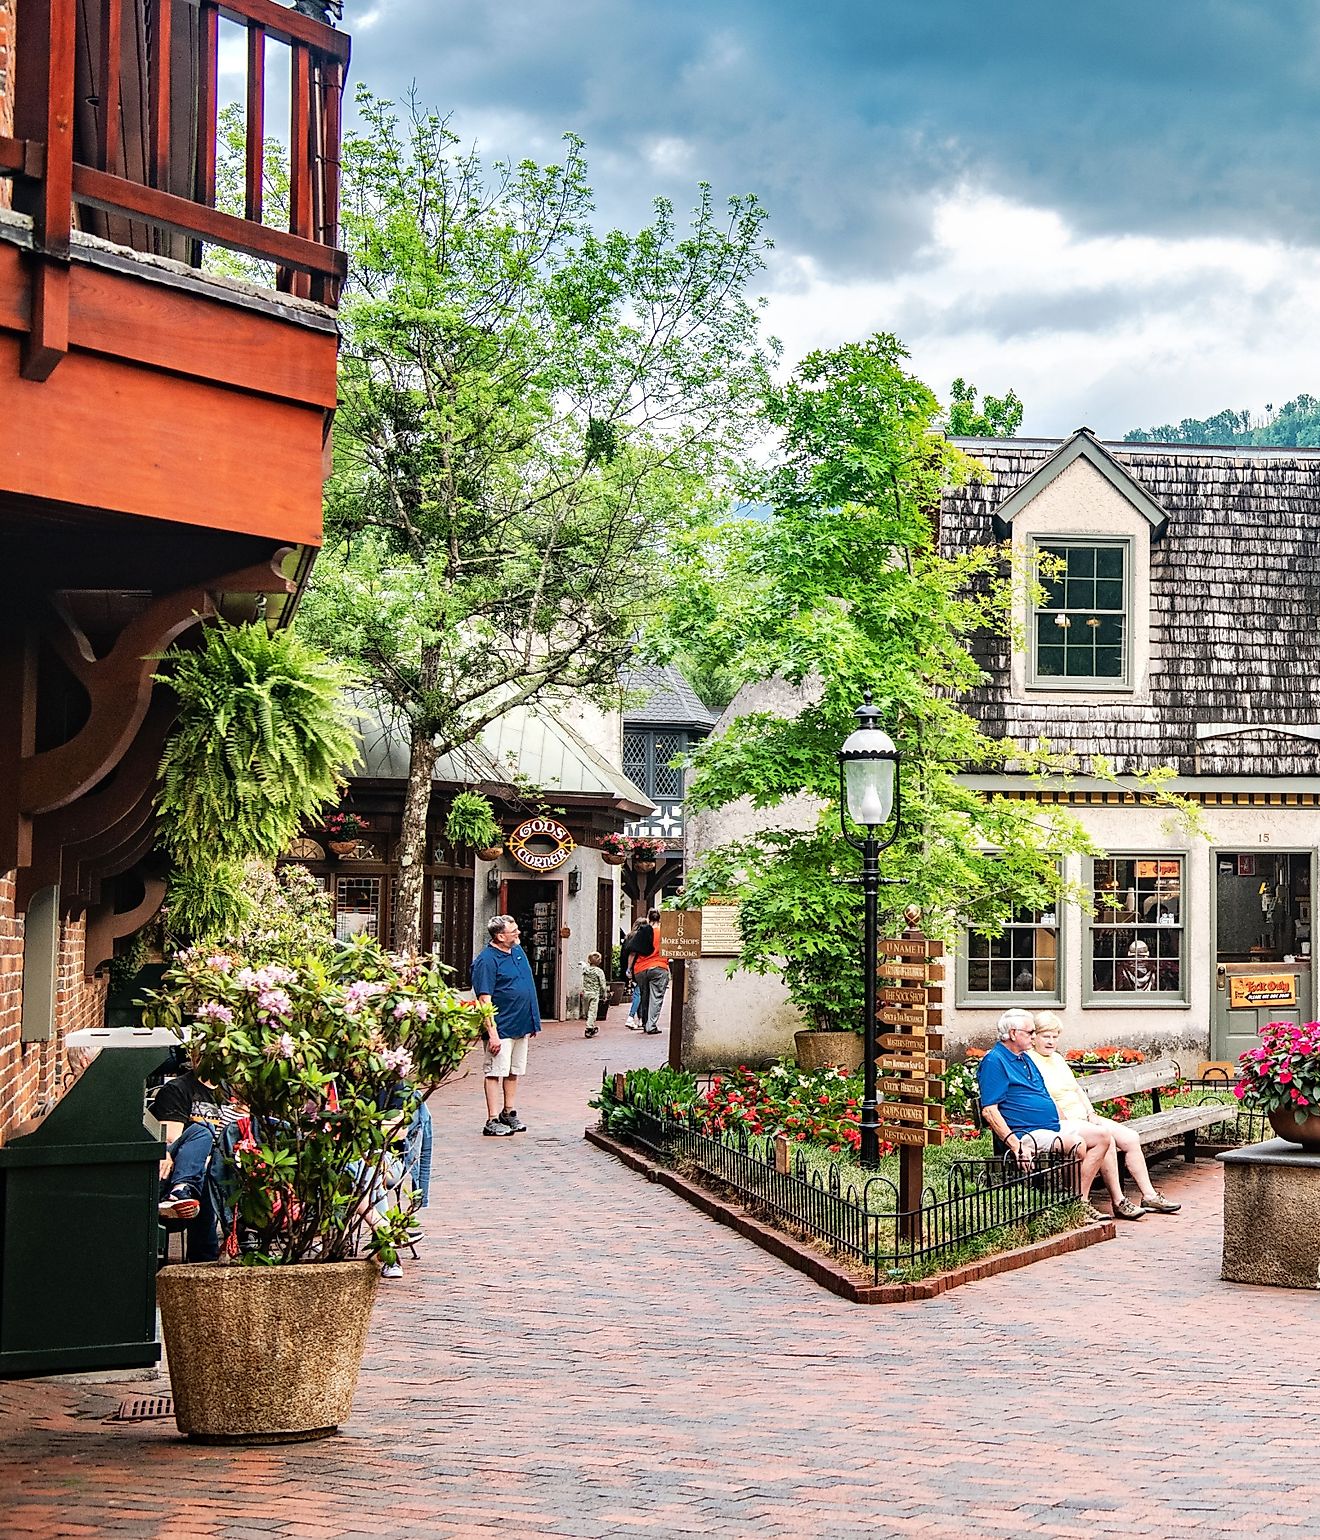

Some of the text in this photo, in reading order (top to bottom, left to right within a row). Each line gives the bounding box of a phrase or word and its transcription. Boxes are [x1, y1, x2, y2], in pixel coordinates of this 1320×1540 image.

[1258, 833, 1270, 843] 15
[677, 927, 684, 936] 8
[886, 943, 893, 952] U
[894, 943, 917, 953] NAME
[896, 989, 909, 1001] SOCK
[910, 990, 925, 1002] SHOP
[884, 1129, 924, 1142] RESTROOMS
